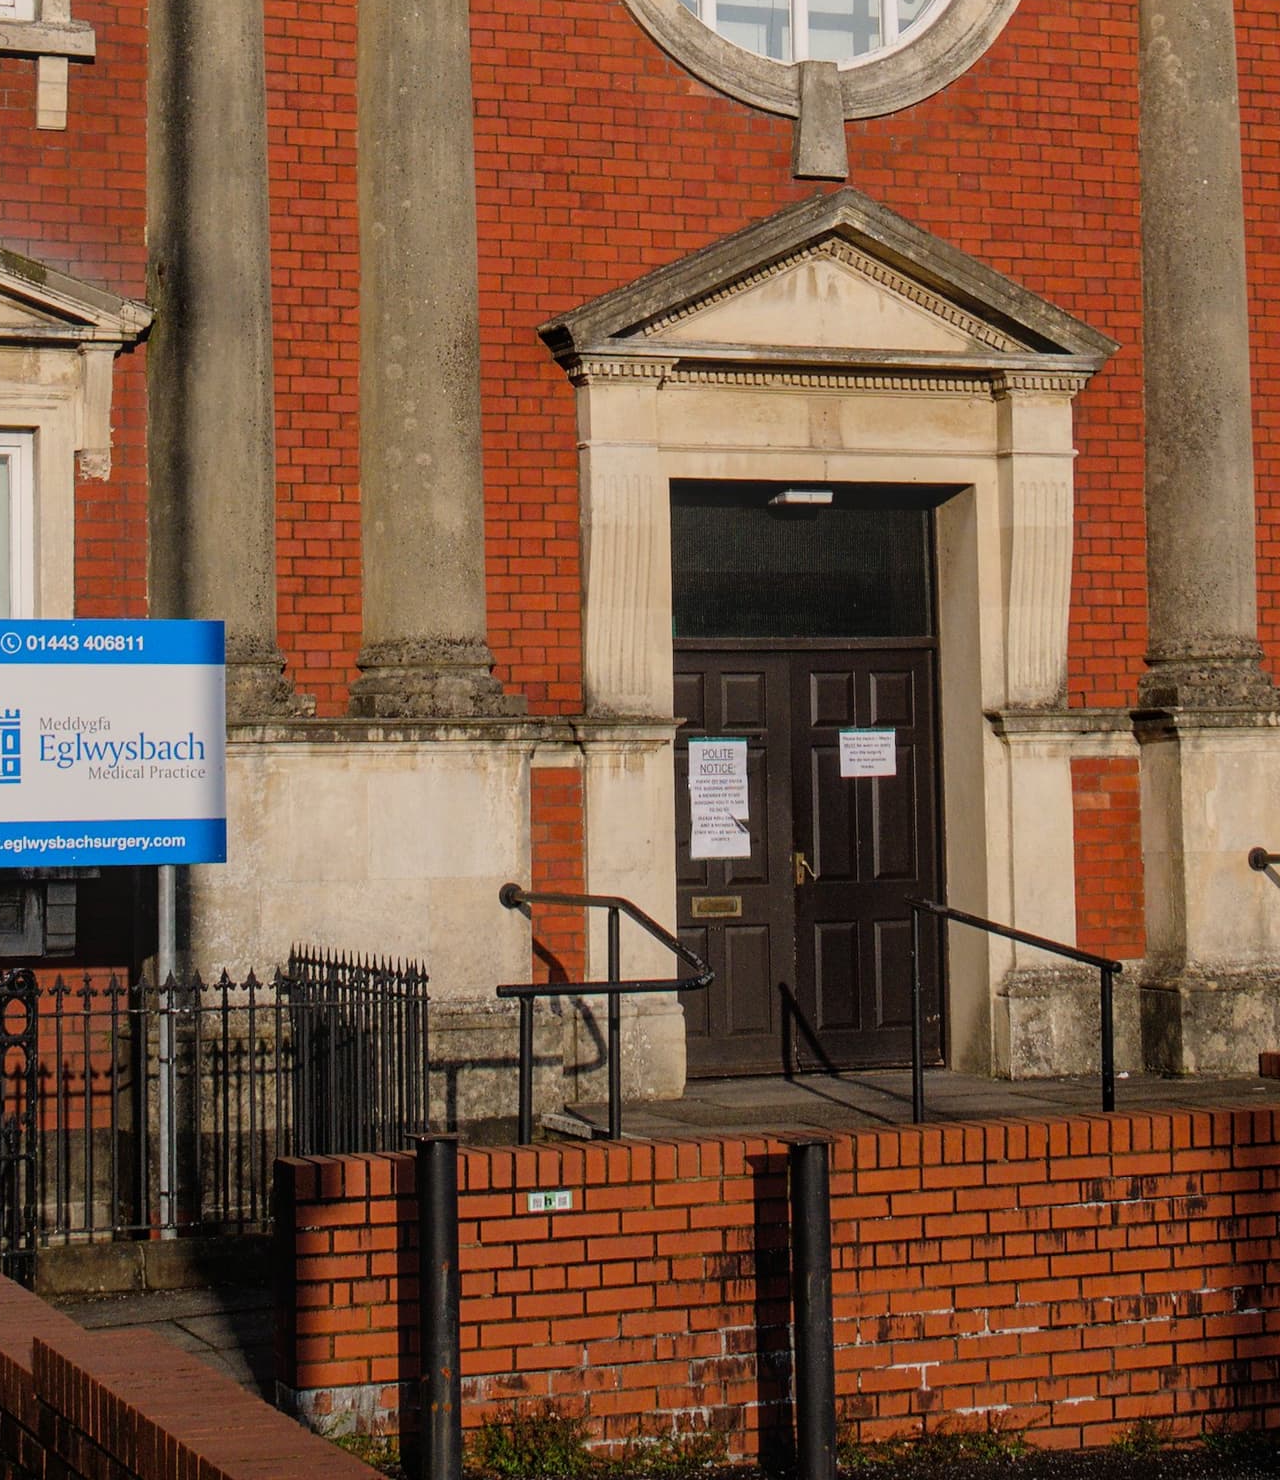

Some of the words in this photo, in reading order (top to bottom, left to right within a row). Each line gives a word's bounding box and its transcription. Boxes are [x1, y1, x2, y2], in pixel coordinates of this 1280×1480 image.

[26, 635, 79, 651] 01443
[83, 635, 144, 651] 406811
[39, 716, 111, 733] Meddygfa
[39, 732, 205, 768] Eglwysbach
[702, 748, 734, 760] POLITE
[88, 766, 144, 780] Medical
[150, 766, 206, 779] Practice
